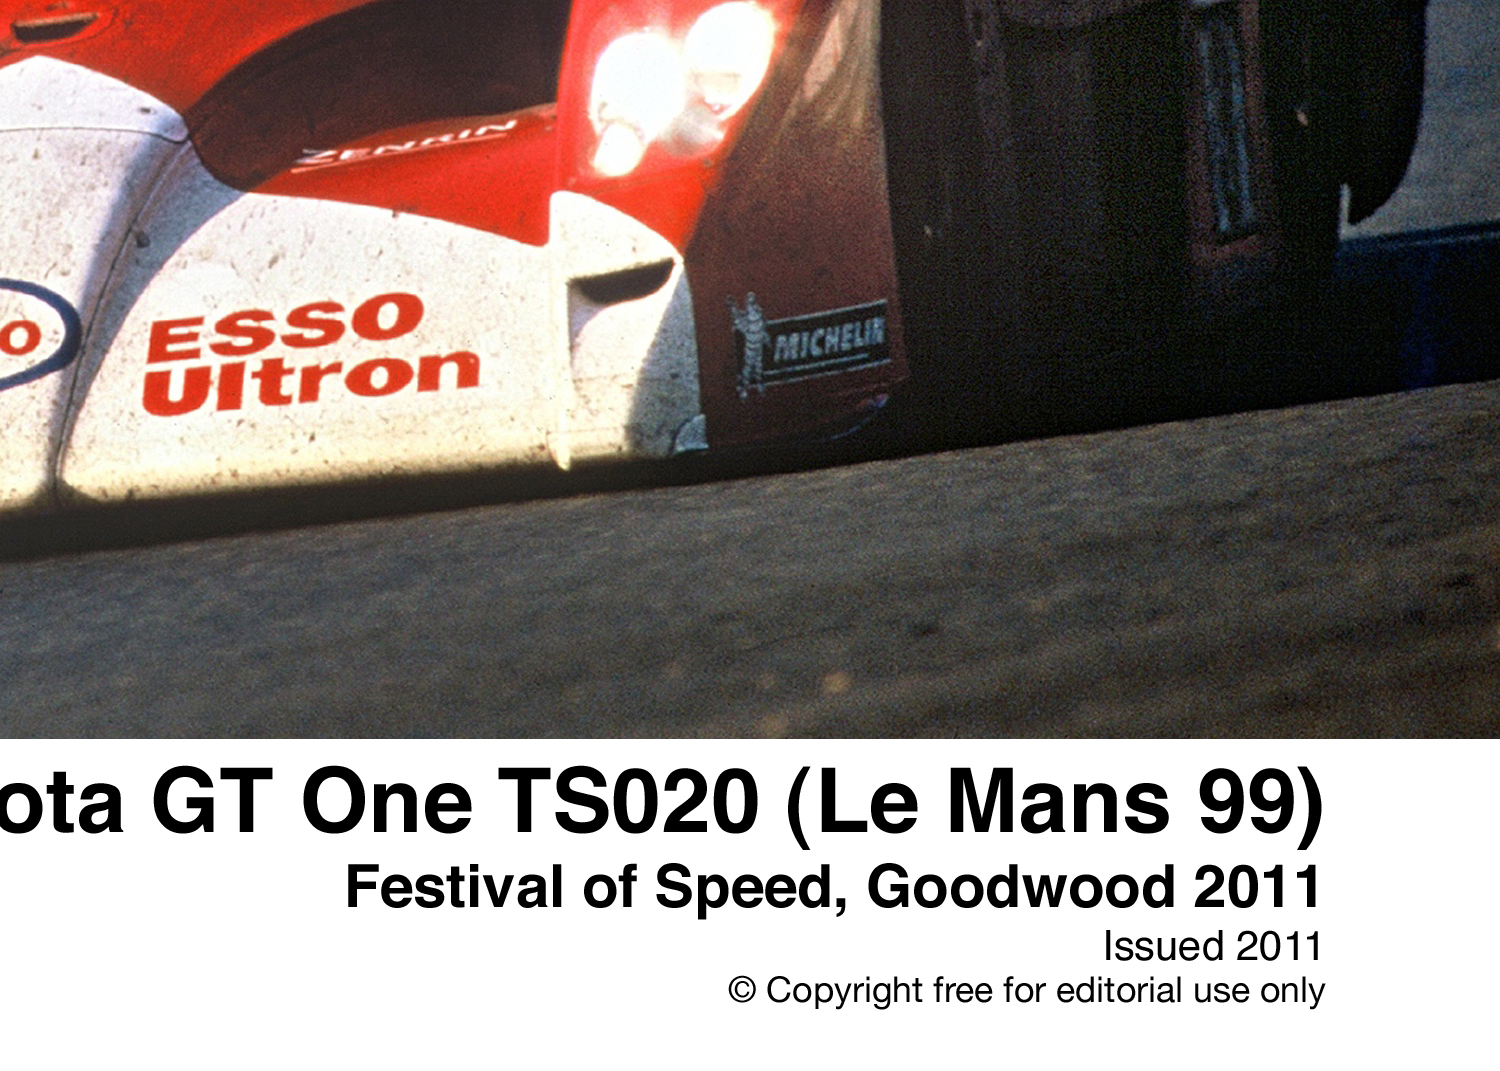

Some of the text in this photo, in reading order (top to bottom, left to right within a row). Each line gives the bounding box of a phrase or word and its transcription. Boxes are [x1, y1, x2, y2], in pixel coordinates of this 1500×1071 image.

[297, 119, 518, 164] ZENRIN
[147, 293, 425, 366] ESSO
[774, 316, 886, 363] MICHELIN
[142, 350, 481, 417] Ultron
